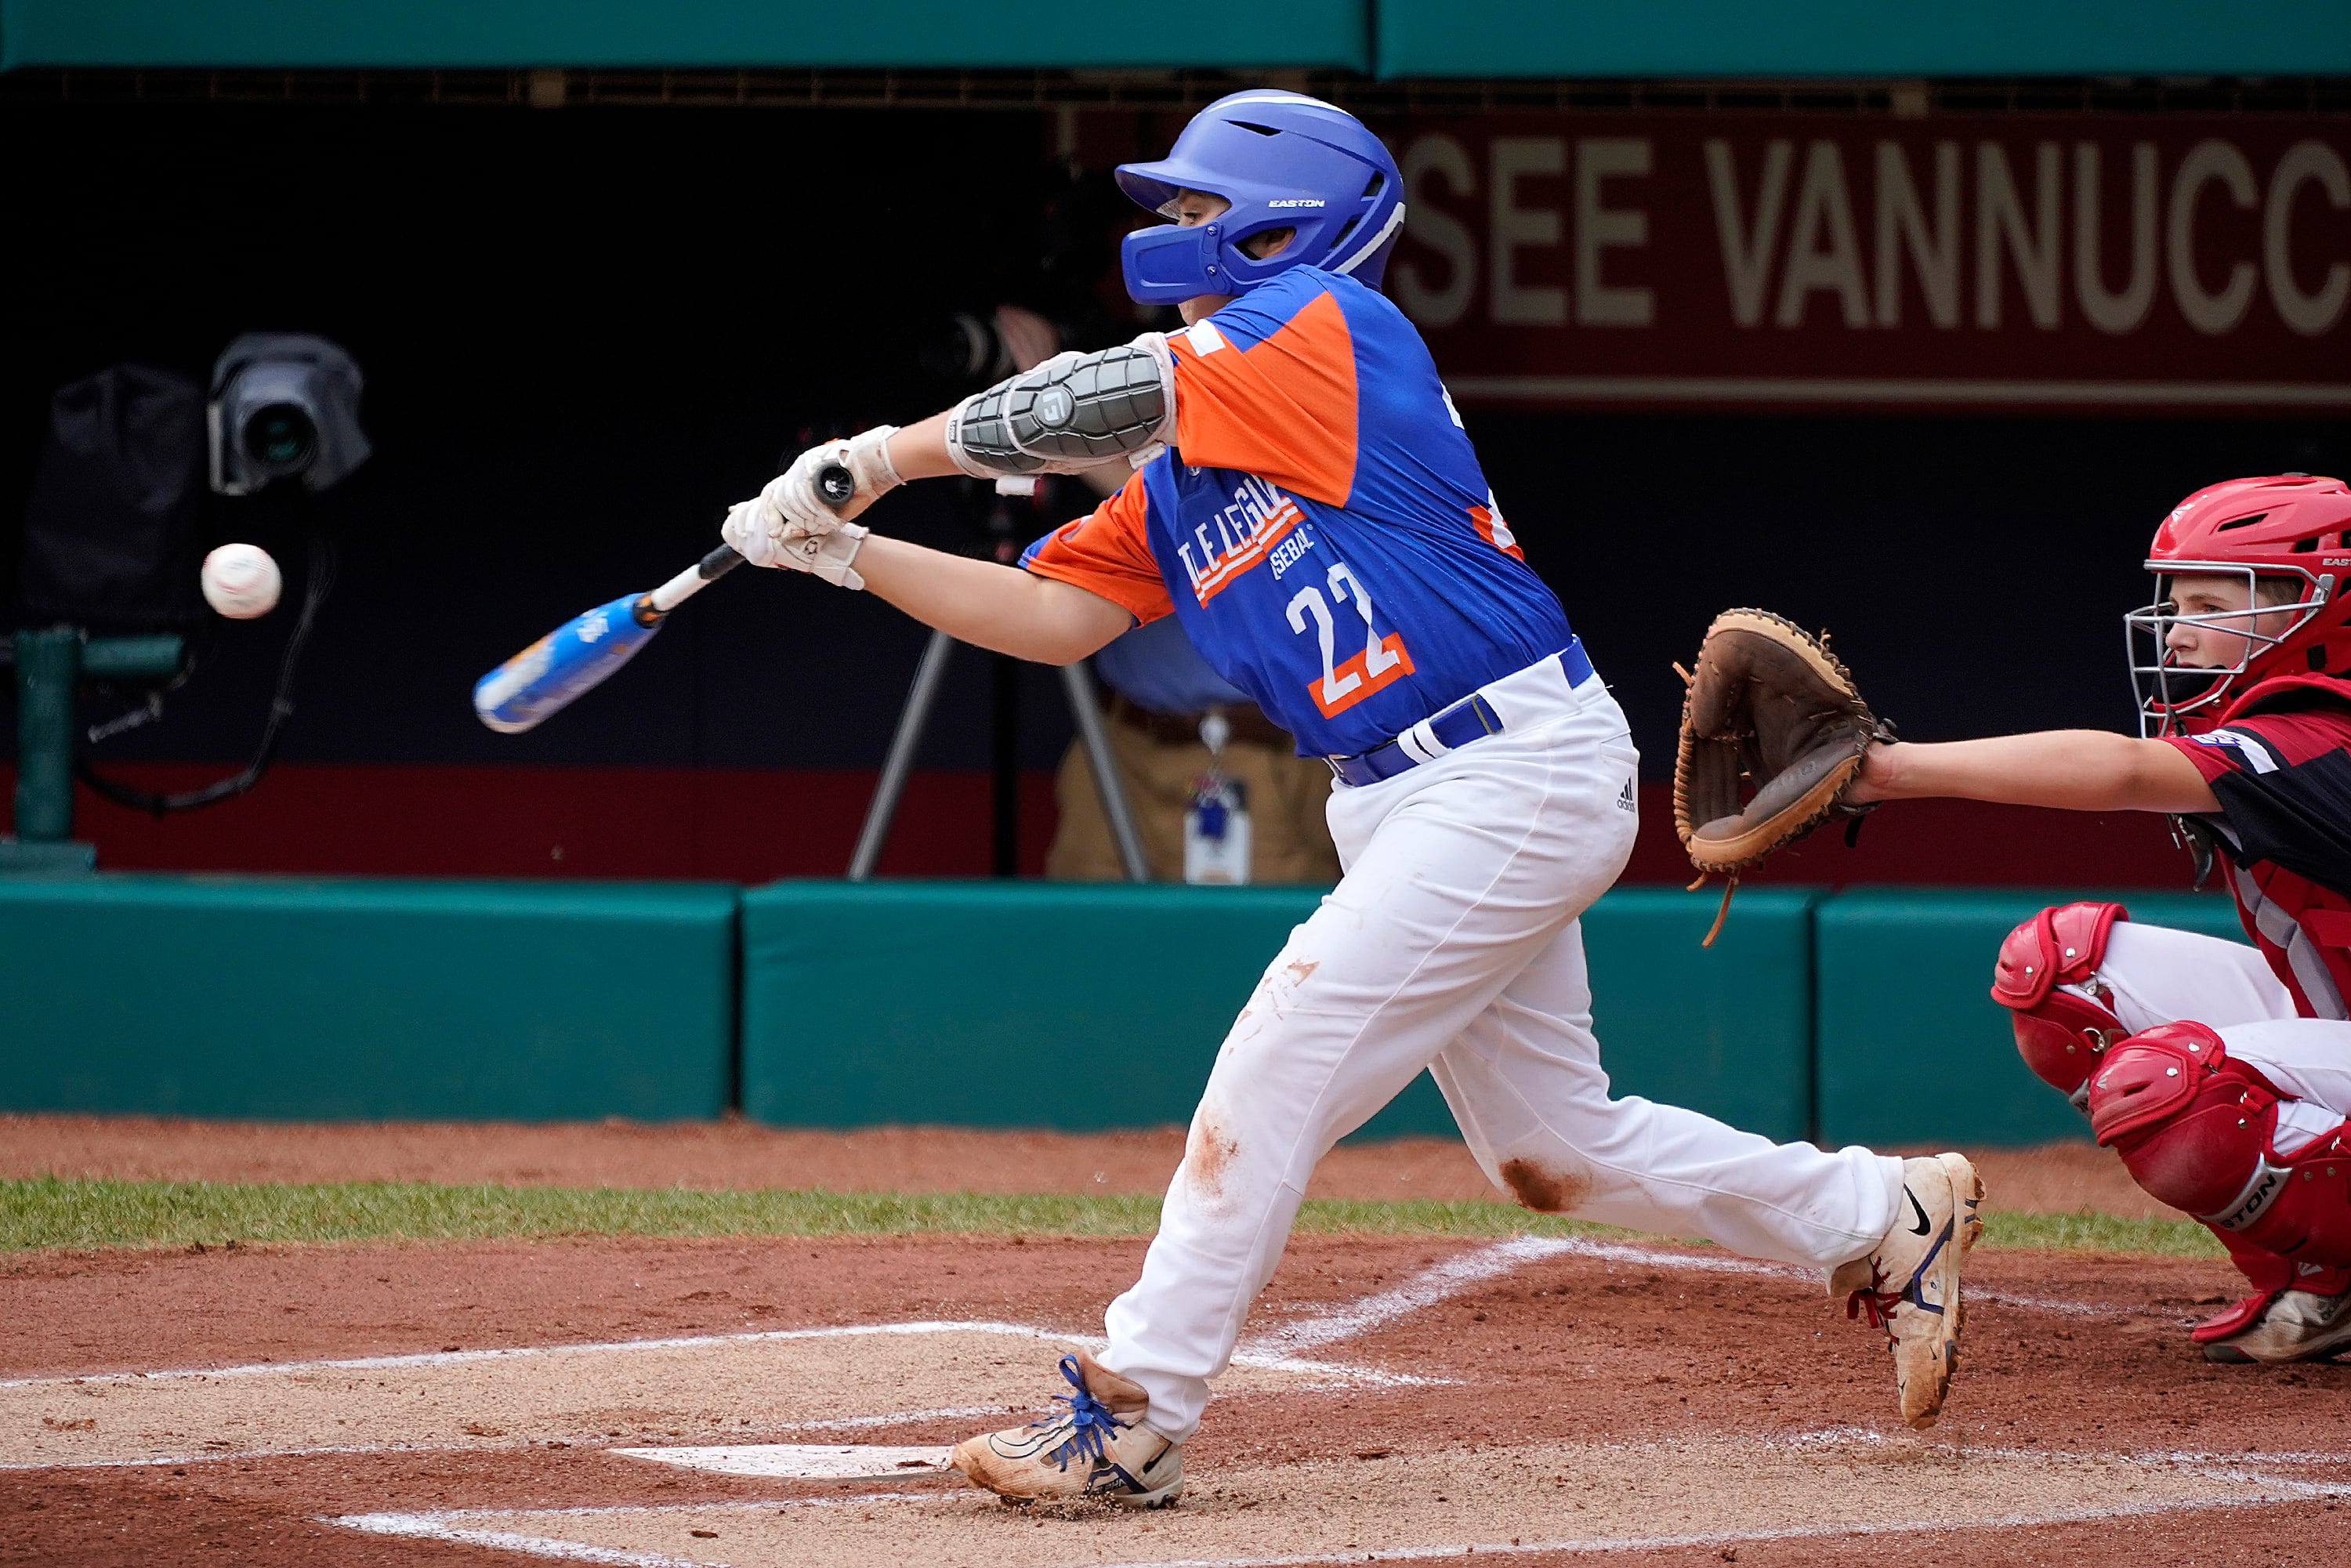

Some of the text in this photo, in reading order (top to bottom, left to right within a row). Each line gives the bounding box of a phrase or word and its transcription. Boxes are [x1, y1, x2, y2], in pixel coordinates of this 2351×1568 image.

[1392, 138, 2351, 334] SEE VANNUCC
[1285, 561, 1401, 705] 22
[2322, 557, 2351, 567] EAS
